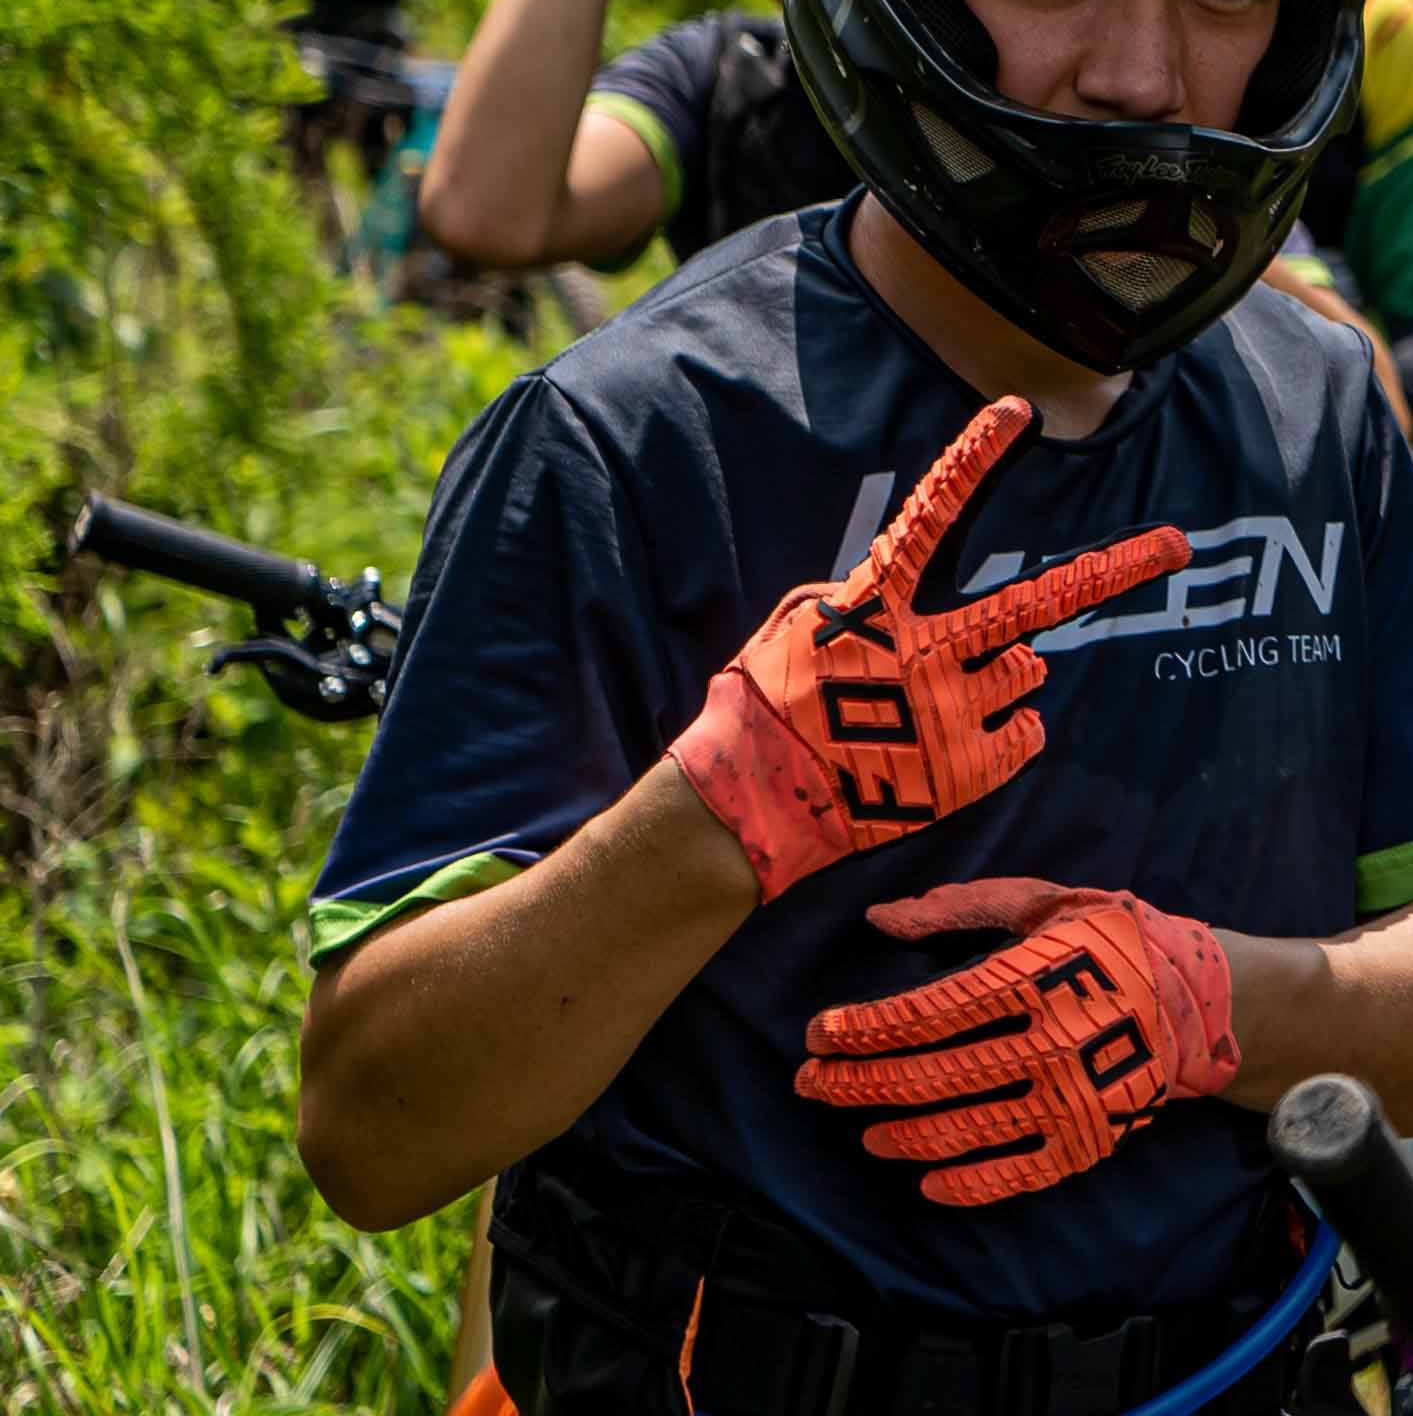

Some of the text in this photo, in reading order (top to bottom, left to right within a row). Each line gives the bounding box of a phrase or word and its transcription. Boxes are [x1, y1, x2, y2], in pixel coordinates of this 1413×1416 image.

[813, 595, 938, 822] FOX
[1288, 634, 1341, 663] TEAM
[1034, 951, 1168, 1152] FOX
